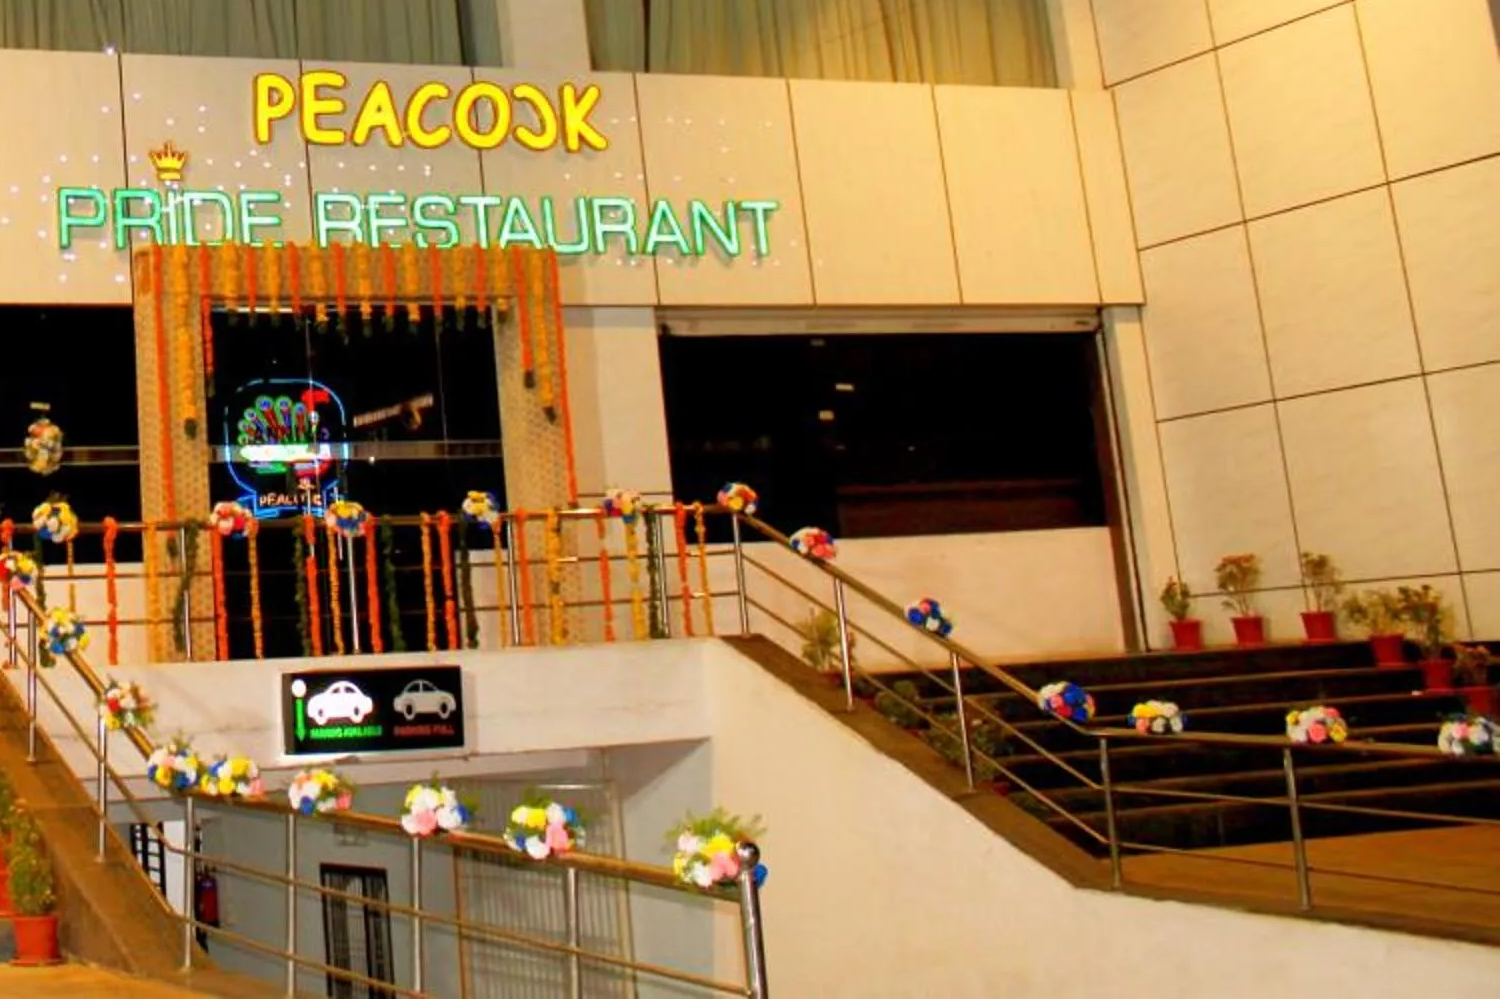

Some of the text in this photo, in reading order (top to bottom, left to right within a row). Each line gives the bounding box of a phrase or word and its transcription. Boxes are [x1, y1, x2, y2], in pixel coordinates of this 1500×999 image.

[253, 70, 608, 153] PEACOCK
[57, 187, 780, 258] PRIDE RESTAURANT
